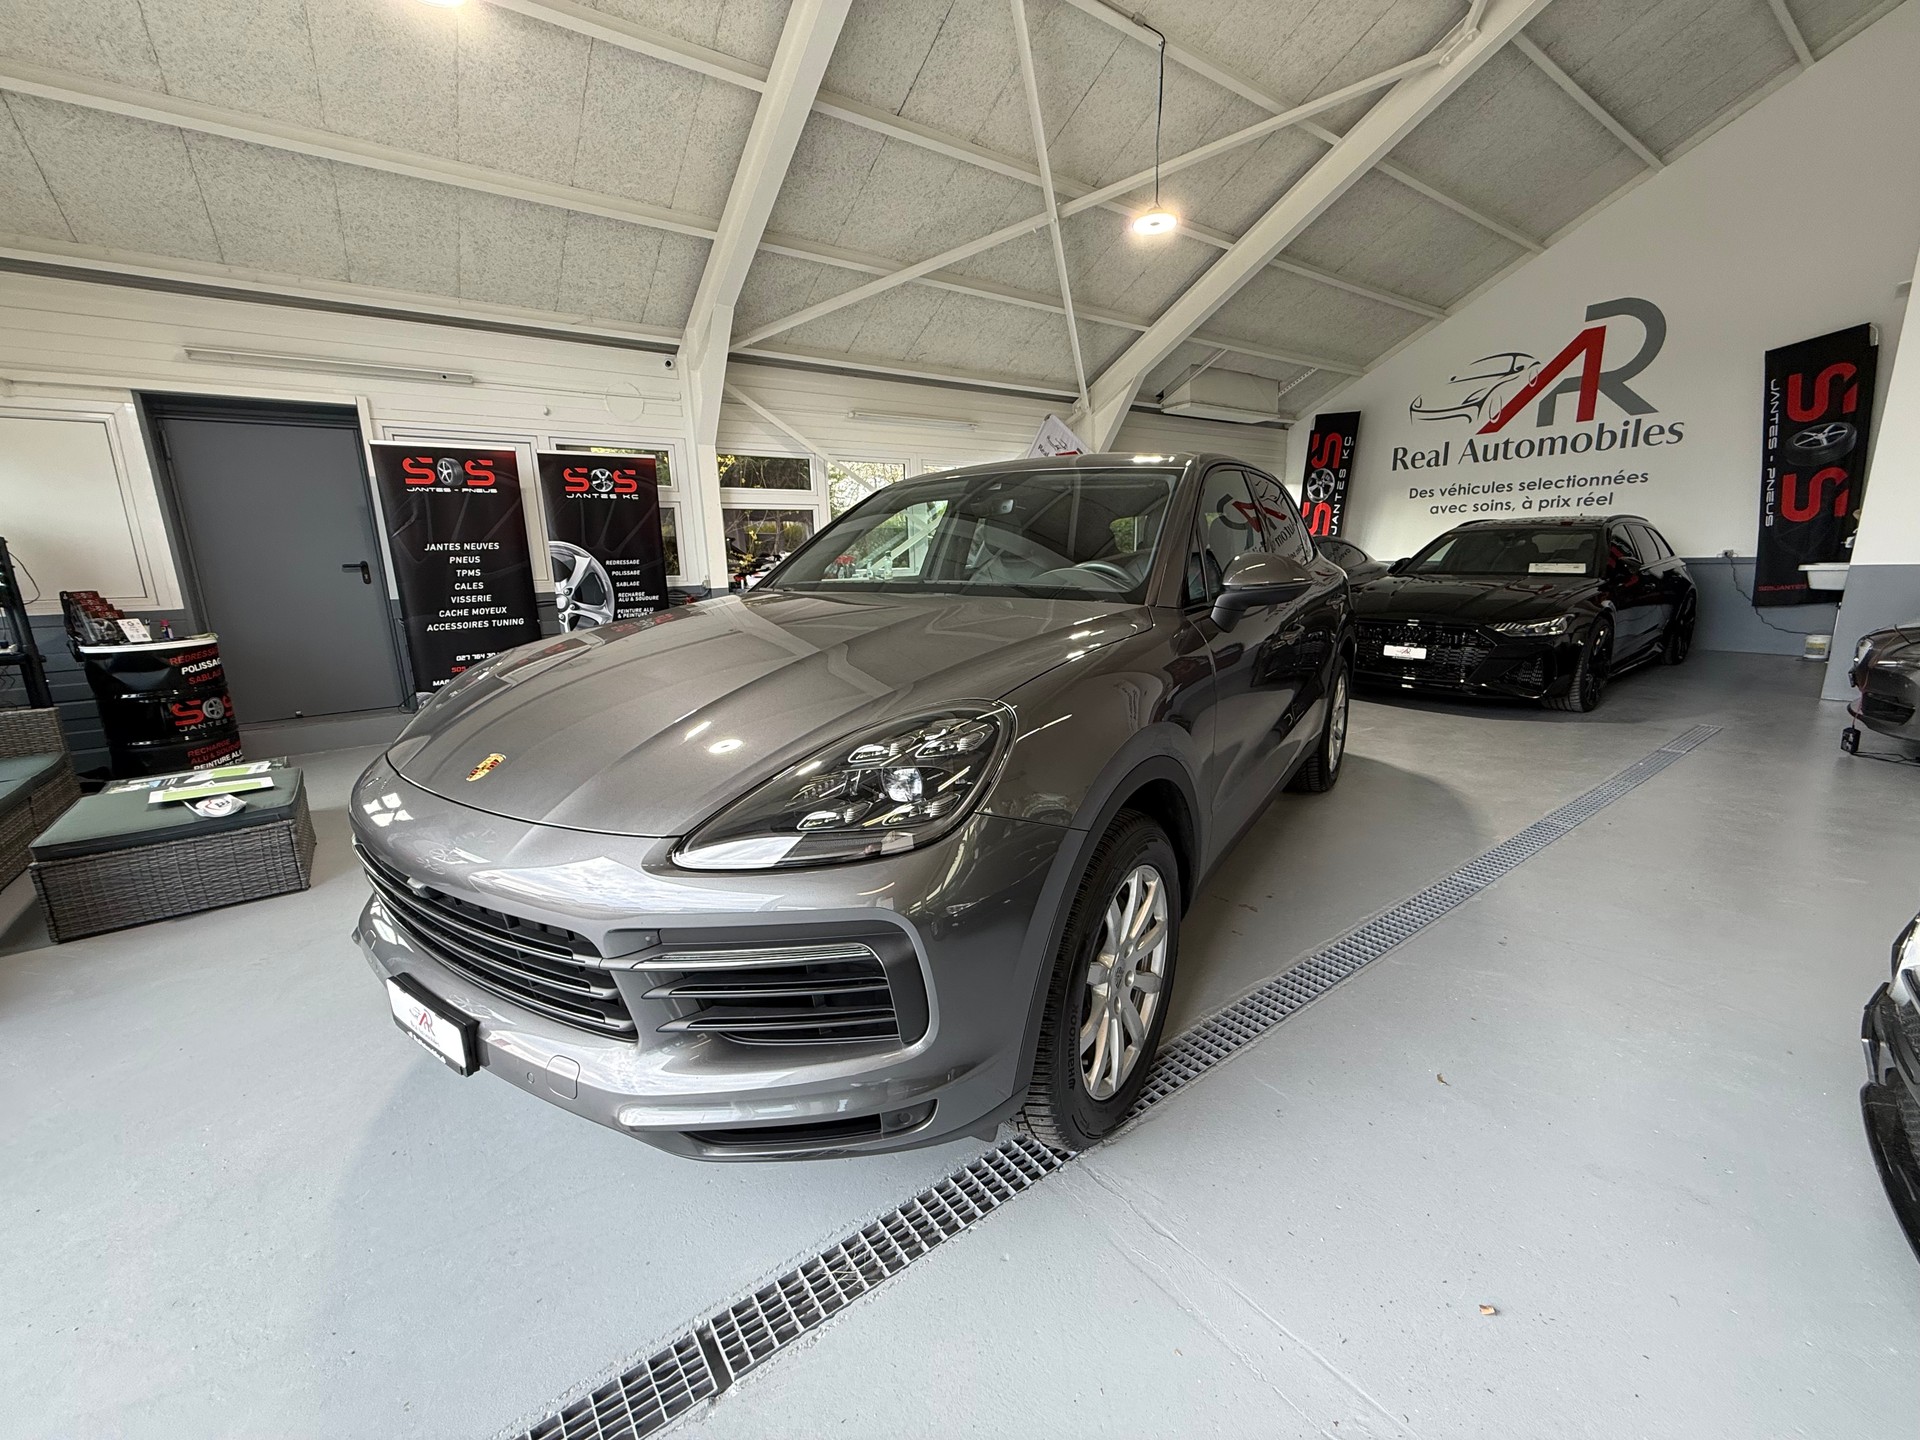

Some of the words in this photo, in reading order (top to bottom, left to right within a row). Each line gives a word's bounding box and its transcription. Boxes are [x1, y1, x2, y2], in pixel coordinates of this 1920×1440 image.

[1768, 378, 1780, 450] JANTES
[1391, 441, 1451, 472] Real
[1458, 418, 1685, 465] Automobiles
[1409, 487, 1435, 500] Des
[1439, 480, 1514, 497] véhicules
[1518, 470, 1649, 492] selectionnées
[1330, 468, 1347, 536] JANTES
[1429, 502, 1468, 515] avec
[1472, 497, 1517, 513] soins,
[1521, 495, 1533, 510] à
[1538, 494, 1572, 512] prix
[1575, 492, 1614, 507] réel
[1765, 467, 1776, 527] PNEUS
[424, 542, 461, 551] JANTES
[463, 542, 500, 550] NEUVES
[449, 556, 481, 564] PNEUS
[456, 569, 481, 577] TPMS
[454, 582, 484, 590] CALES
[450, 594, 492, 603] VISSERIE
[438, 608, 469, 618] CACHE
[472, 606, 508, 615] MOYEUX
[426, 620, 489, 632] ACCESSOIRES
[492, 618, 525, 627] TUNING
